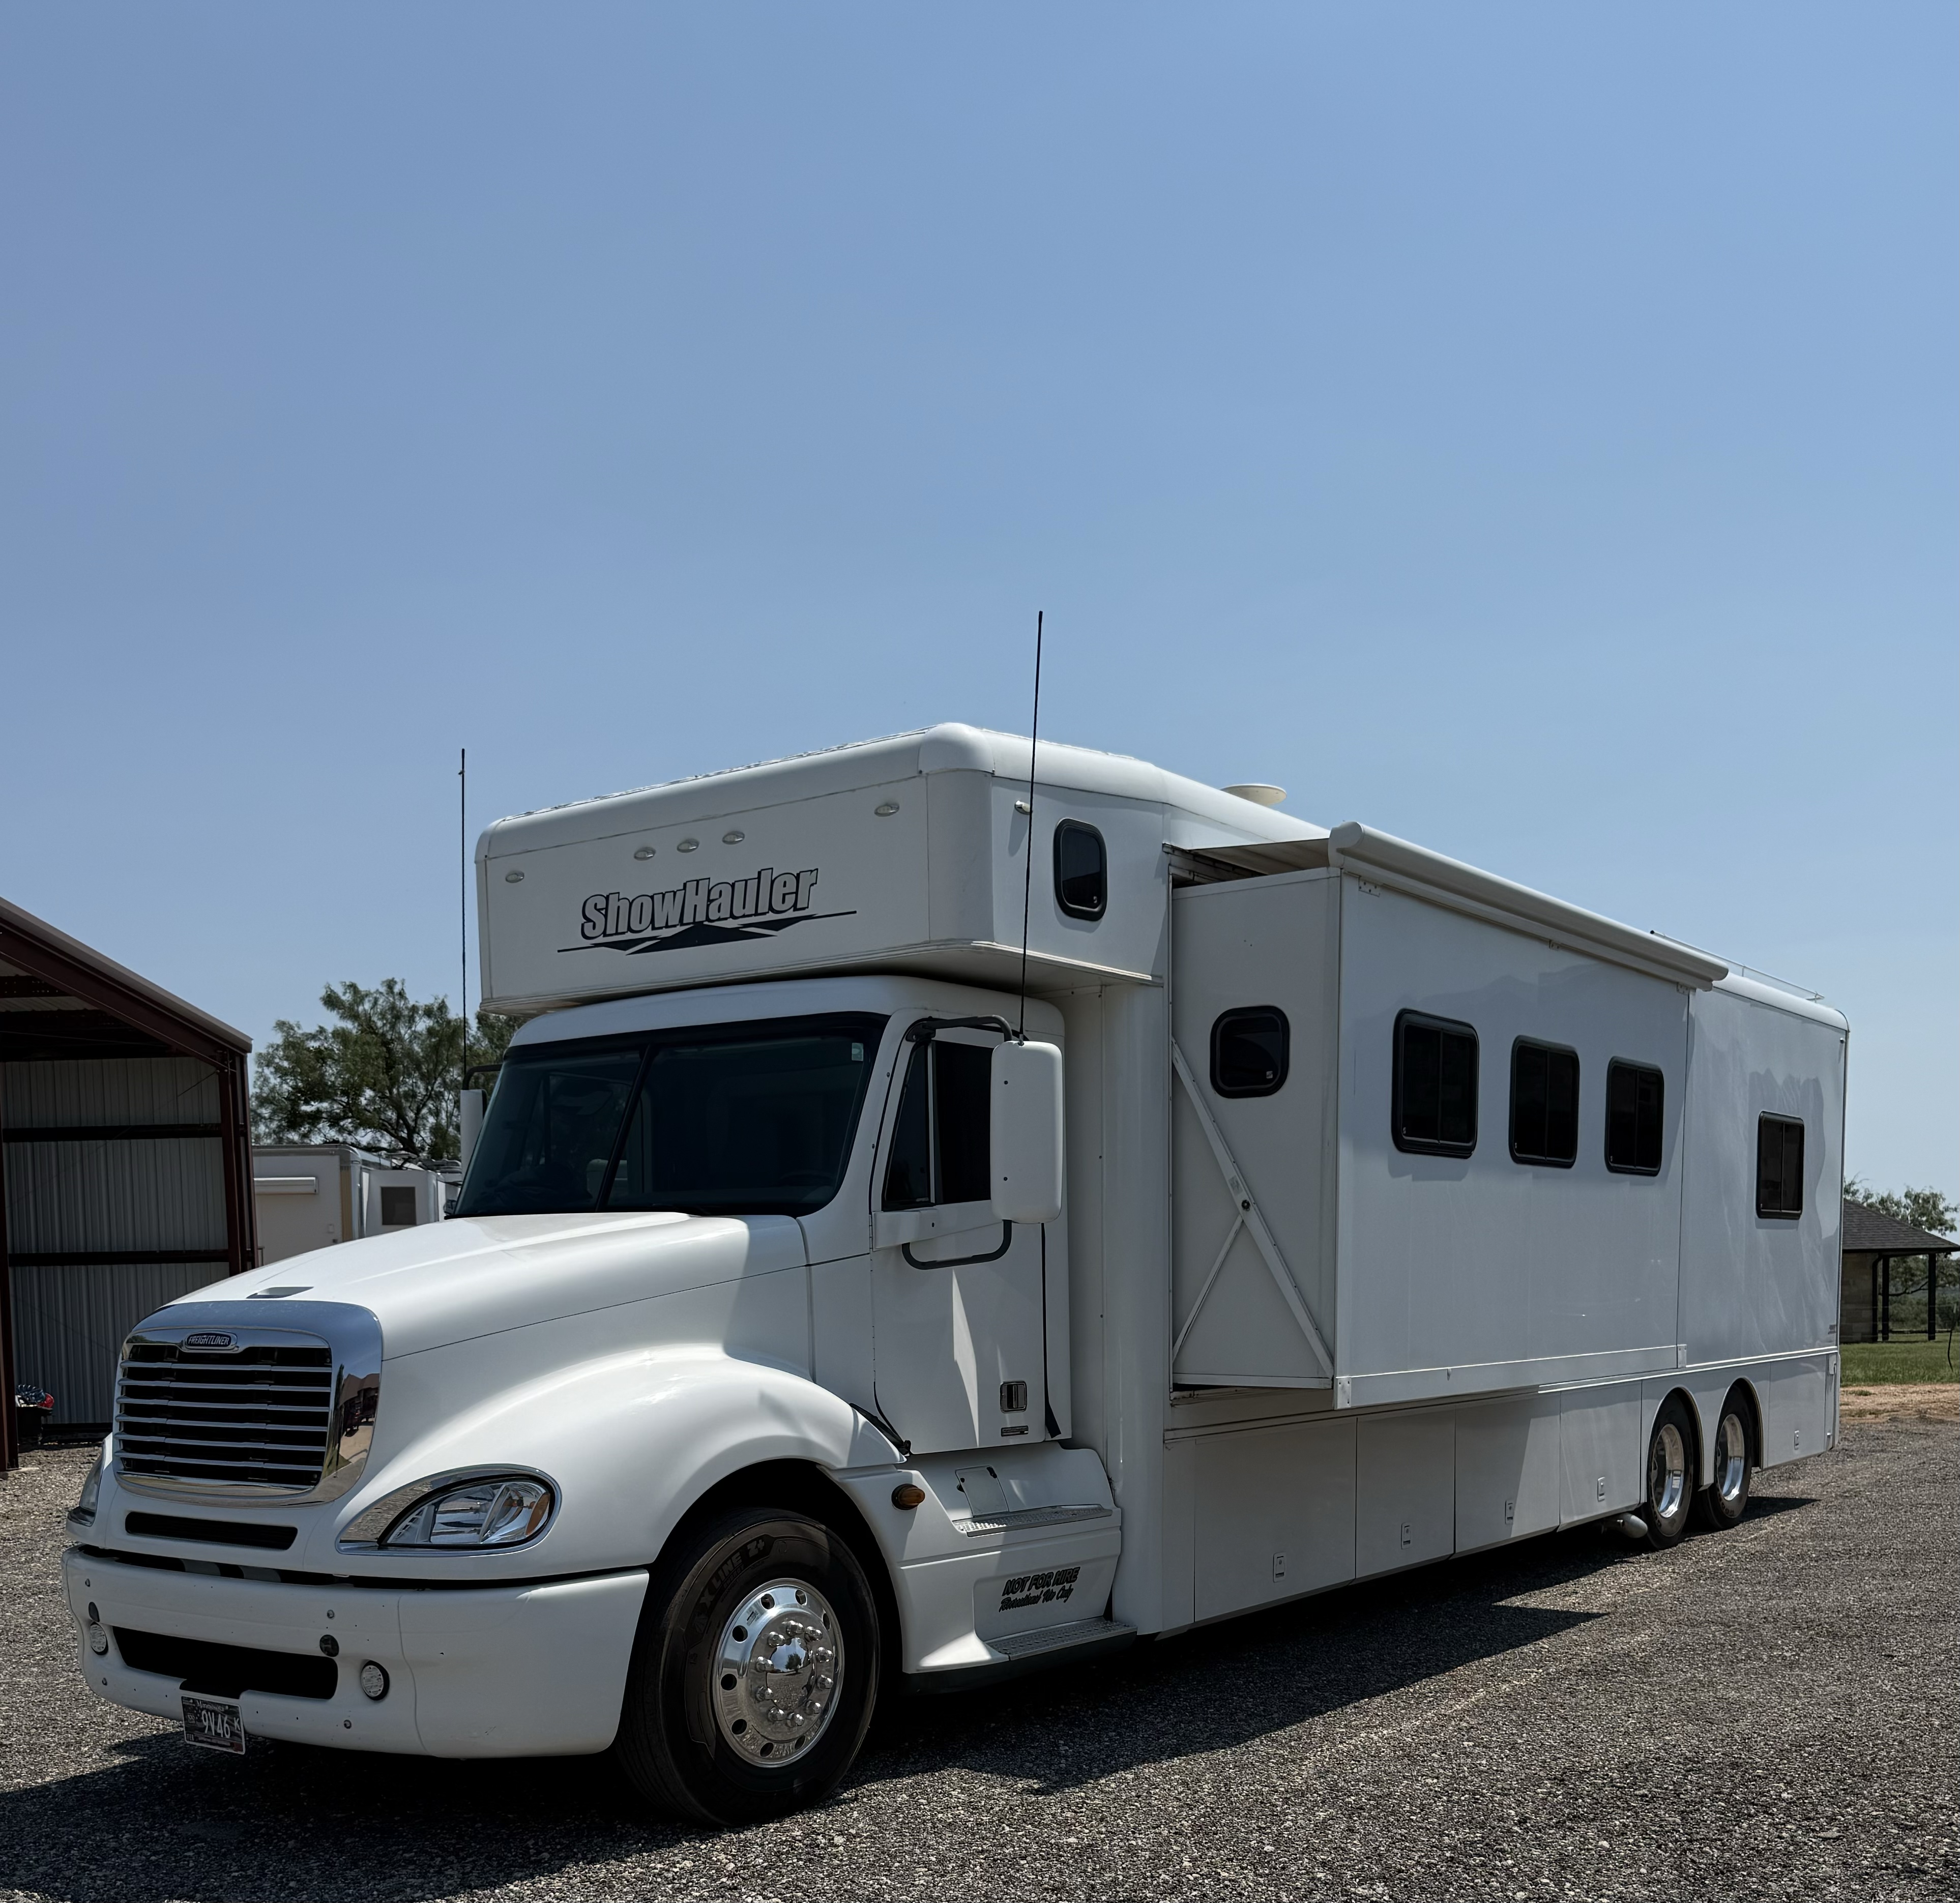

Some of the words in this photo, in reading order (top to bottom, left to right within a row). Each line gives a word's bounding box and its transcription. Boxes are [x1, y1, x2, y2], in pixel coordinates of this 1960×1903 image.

[581, 867, 818, 940] ShowHauler
[188, 1335, 229, 1345] FREIGHTLINER
[712, 1550, 742, 1589] LINE
[1002, 1575, 1031, 1596] NOT
[1027, 1571, 1055, 1592] FOR
[1051, 1566, 1080, 1587] HIRE
[201, 1709, 230, 1739] 9V46
[233, 1717, 241, 1731] K
